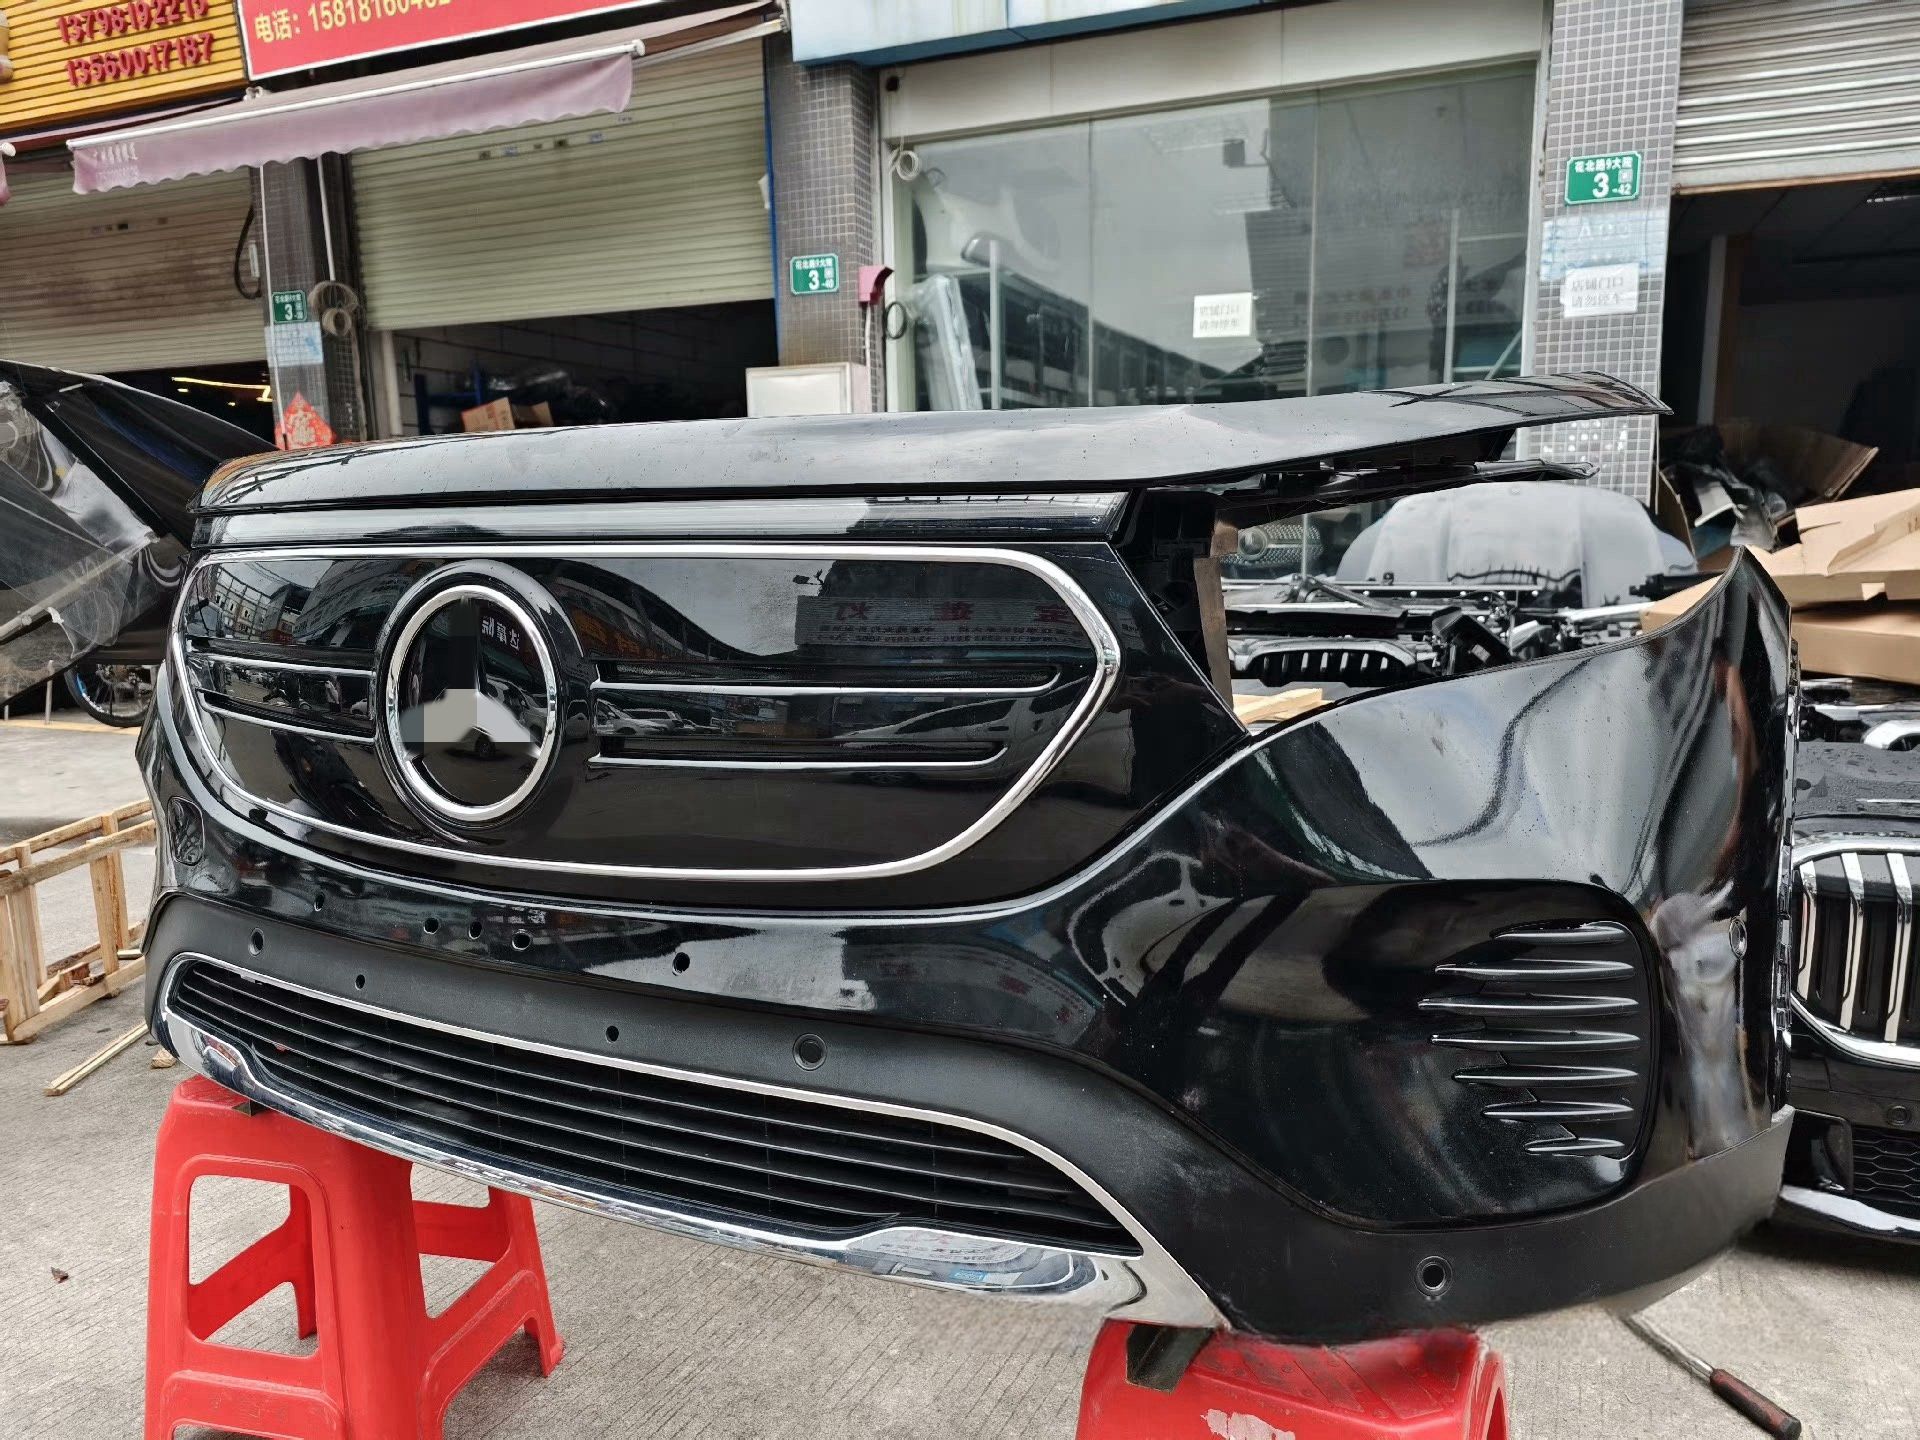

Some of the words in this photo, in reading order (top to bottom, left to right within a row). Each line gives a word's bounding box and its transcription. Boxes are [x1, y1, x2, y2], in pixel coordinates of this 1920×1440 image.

[66, 32, 215, 87] 13560017187
[1592, 172, 1610, 199] 3
[808, 269, 820, 290] 3
[284, 303, 293, 321] 3
